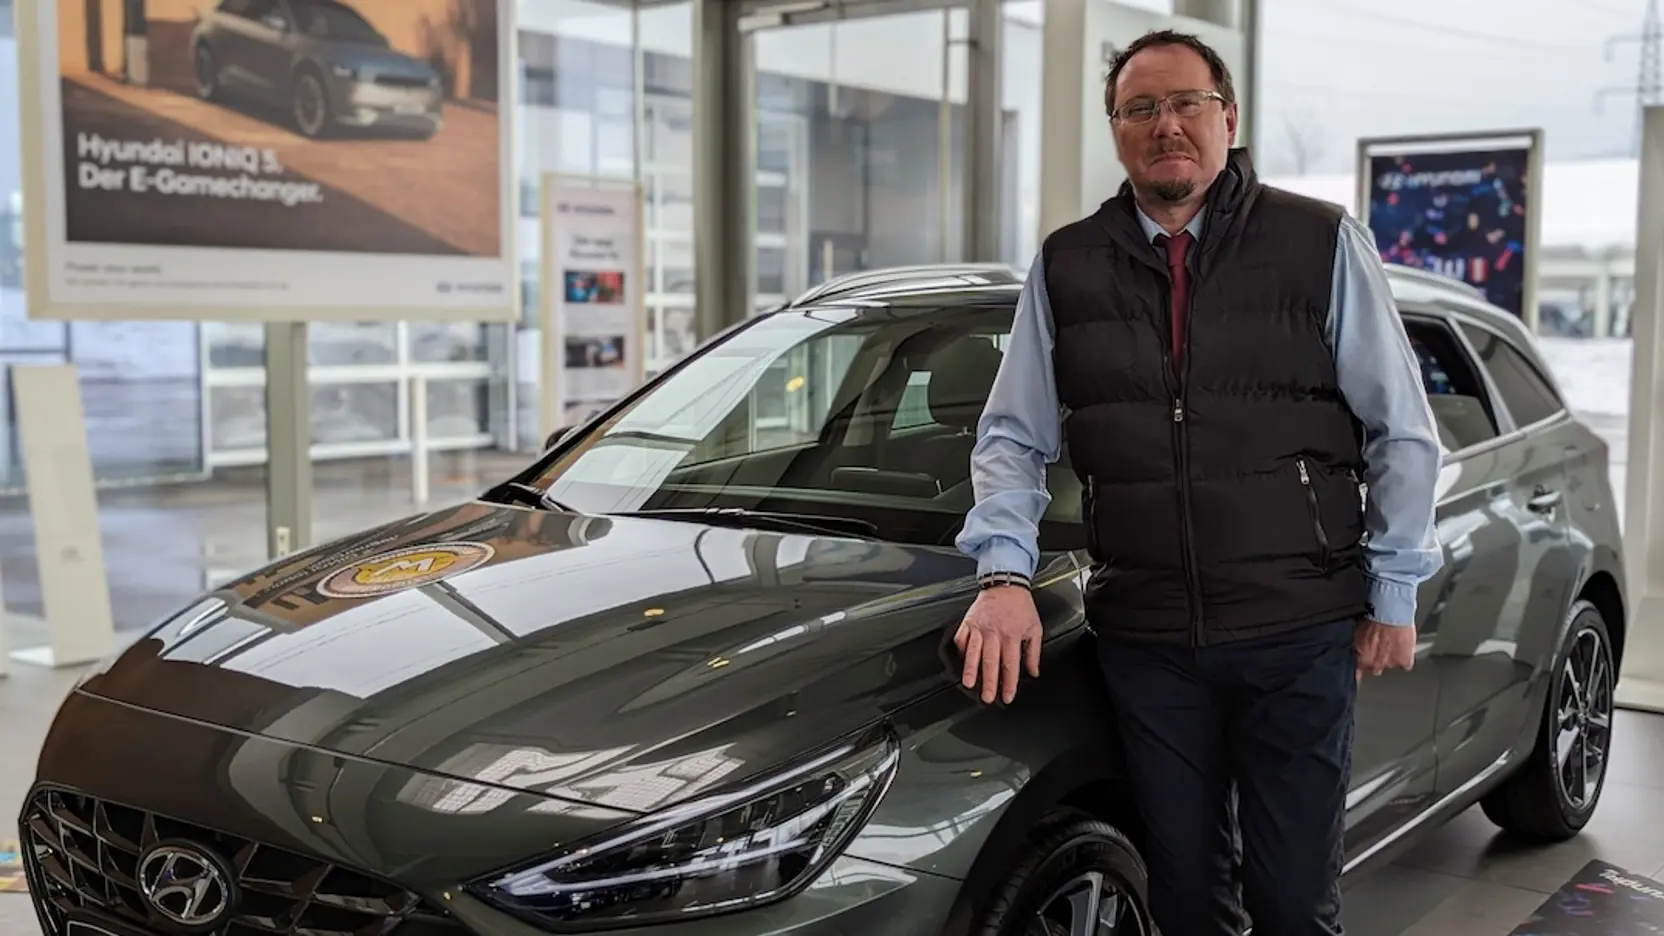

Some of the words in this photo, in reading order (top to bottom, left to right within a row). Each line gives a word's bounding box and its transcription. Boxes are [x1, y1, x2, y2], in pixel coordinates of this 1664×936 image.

[77, 131, 186, 164] Hyundai
[188, 141, 259, 174] IONIQ
[77, 161, 126, 190] Der
[129, 166, 324, 206] E-Gamechanger.
